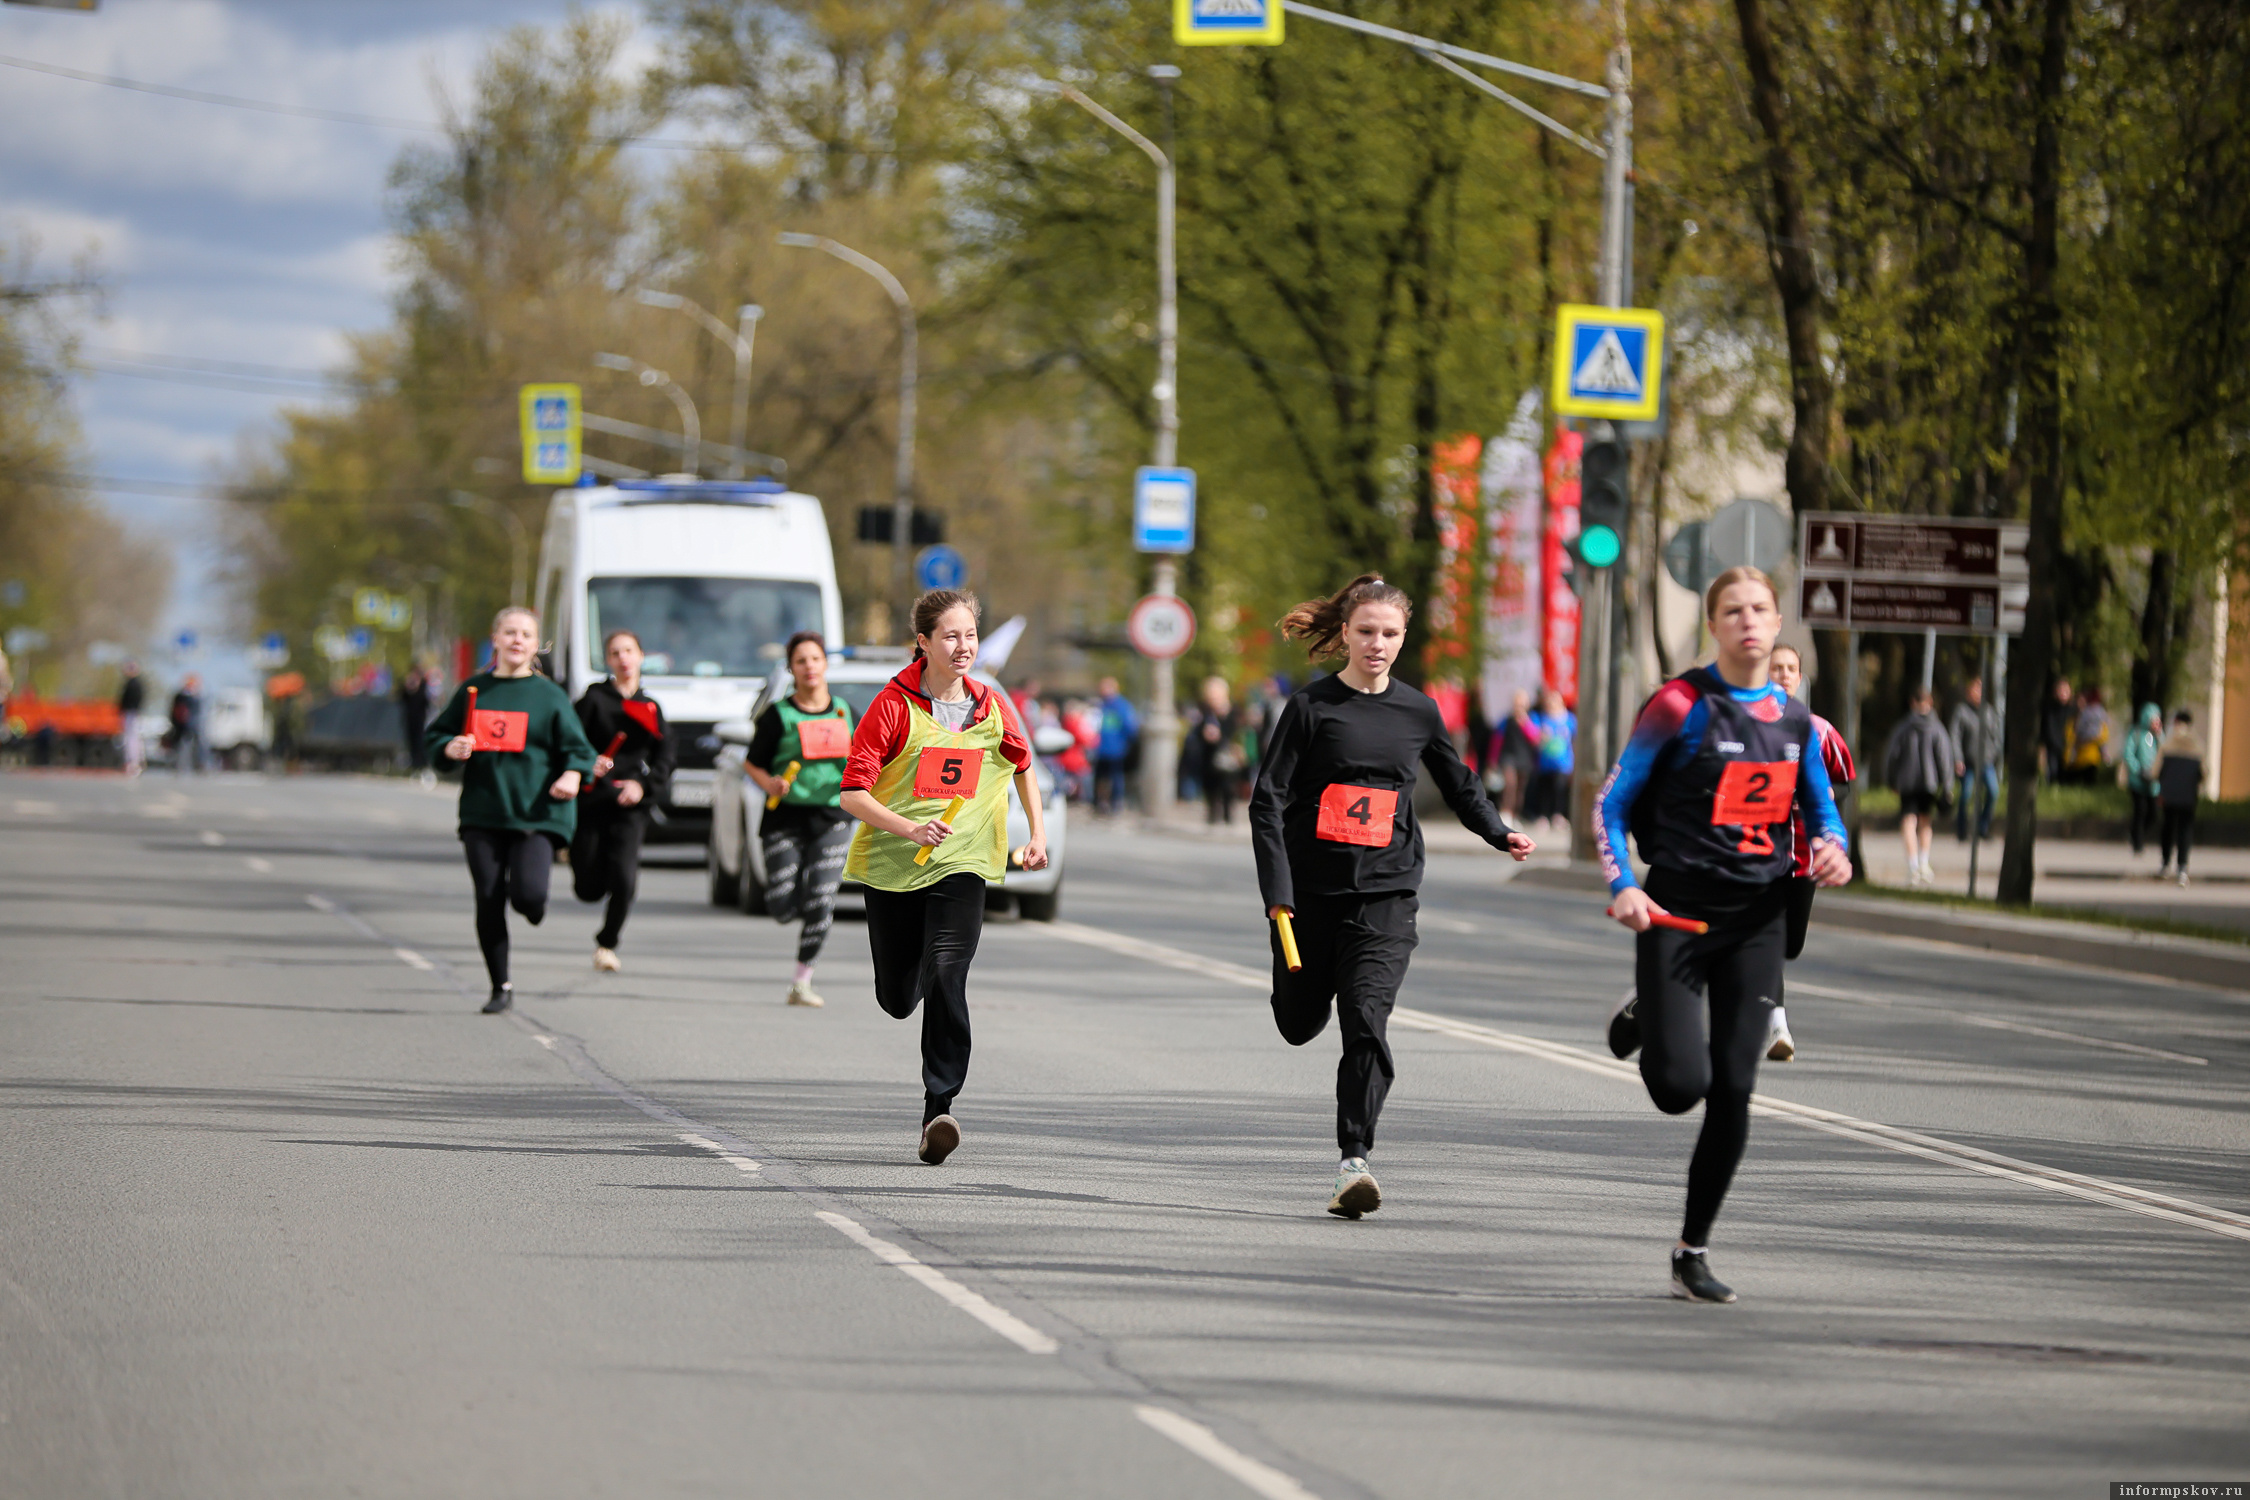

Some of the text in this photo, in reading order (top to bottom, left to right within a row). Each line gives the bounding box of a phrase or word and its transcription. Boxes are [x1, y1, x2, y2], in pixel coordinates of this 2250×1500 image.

[491, 720, 506, 738] 3
[940, 758, 963, 785] 5
[1744, 772, 1770, 803] 2
[1346, 796, 1372, 825] 4
